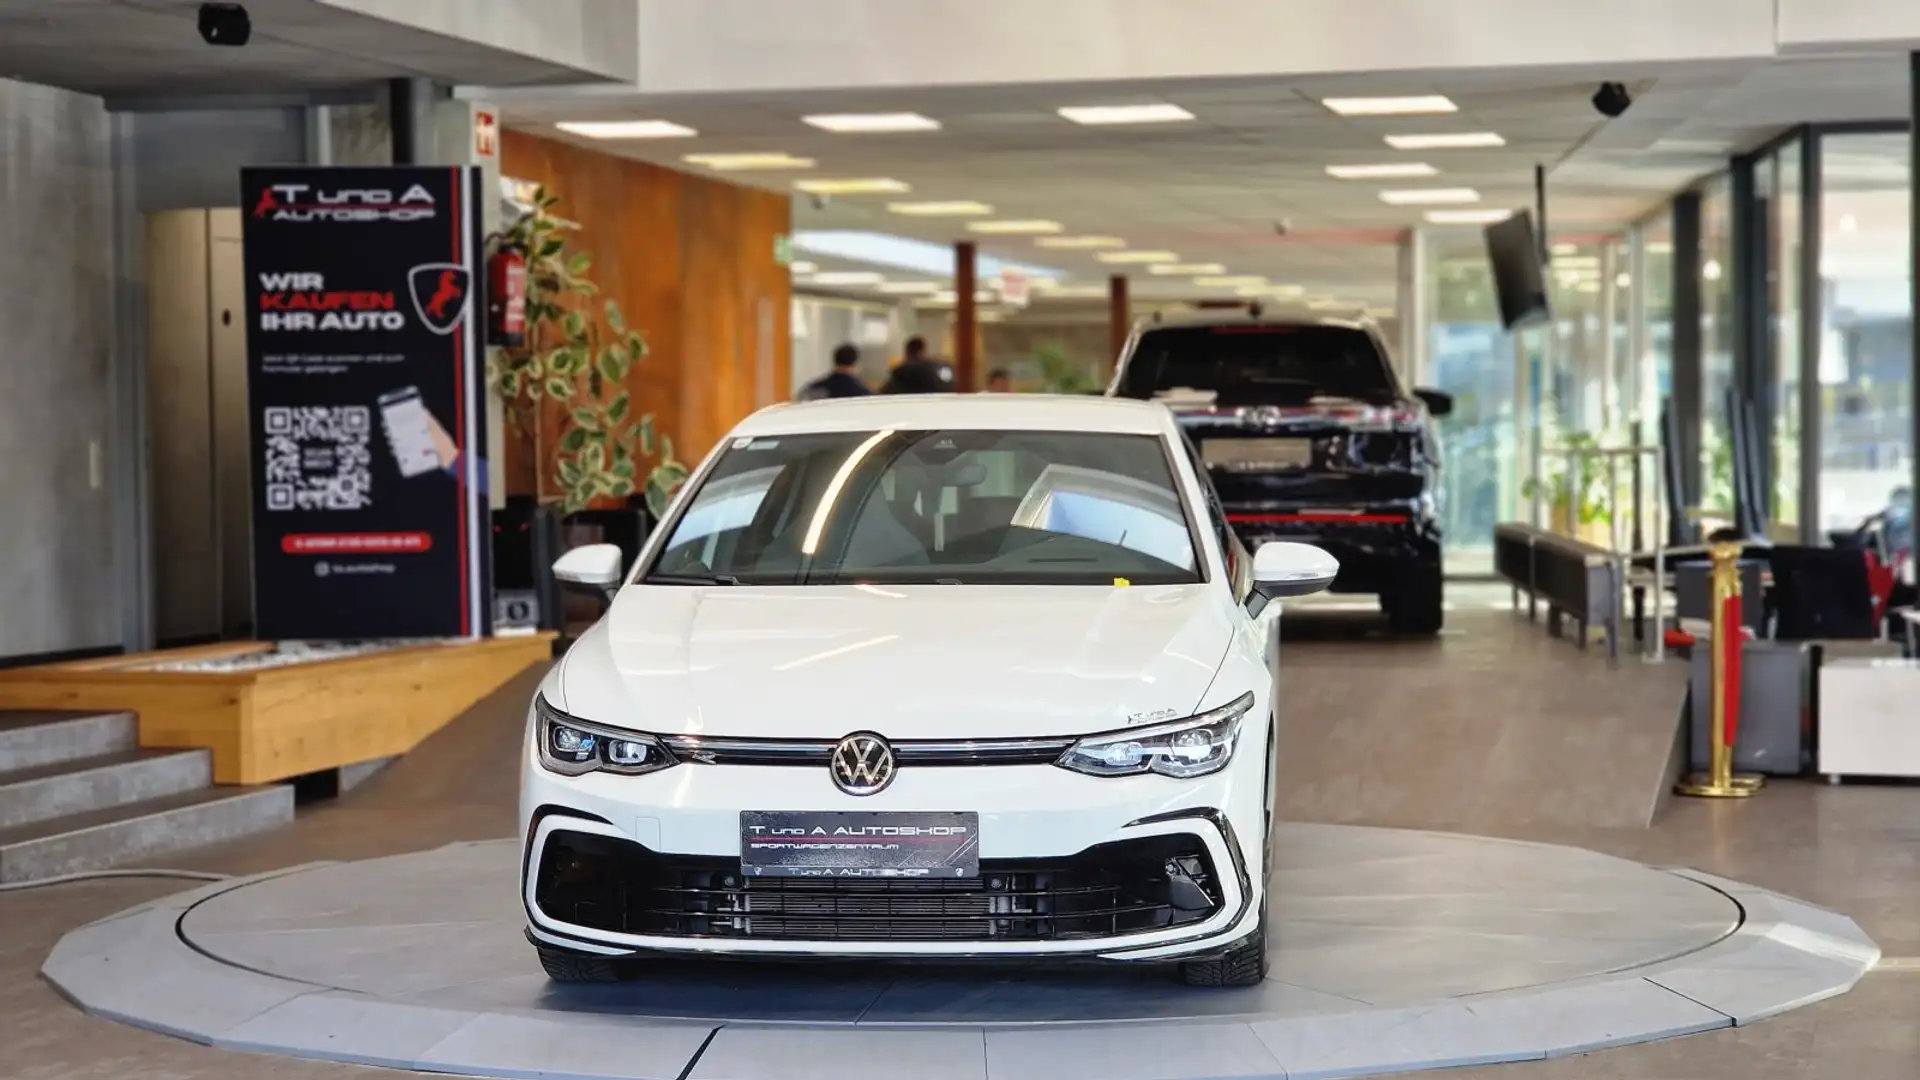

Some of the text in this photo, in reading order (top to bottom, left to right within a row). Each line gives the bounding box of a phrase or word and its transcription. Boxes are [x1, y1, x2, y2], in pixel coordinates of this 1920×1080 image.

[272, 184, 310, 204] T
[400, 184, 436, 204] A
[272, 208, 436, 221] AUTOSHOP
[259, 272, 324, 291] WIR
[260, 291, 394, 310] KAUFEN
[260, 312, 405, 331] IHR AUTO
[749, 825, 766, 835] T
[811, 826, 827, 835] A
[834, 826, 967, 836] AUTOSHOP
[788, 867, 800, 875] T
